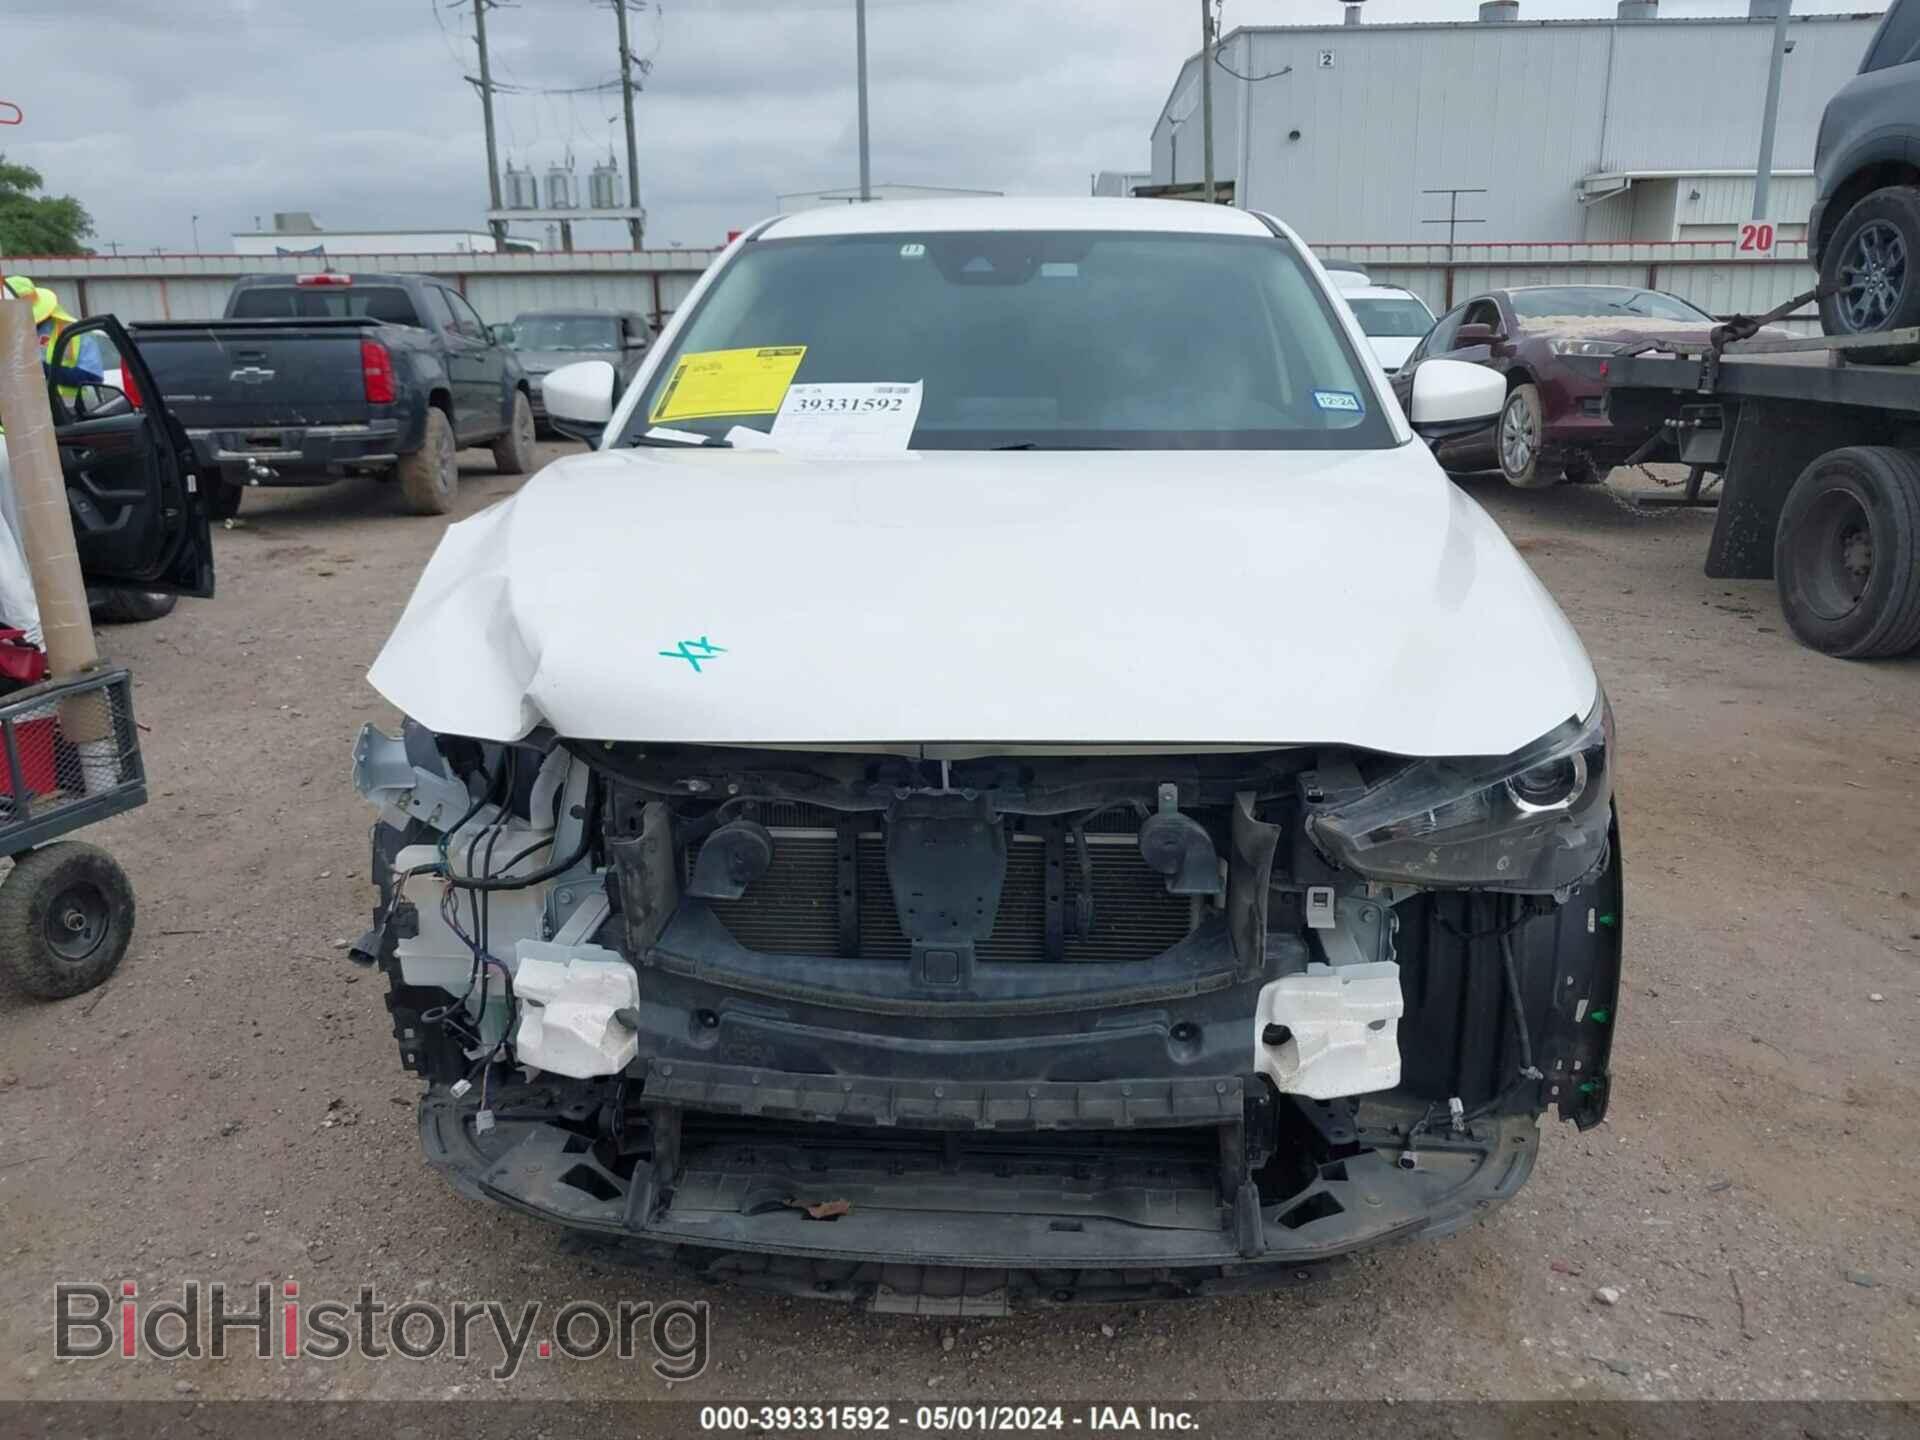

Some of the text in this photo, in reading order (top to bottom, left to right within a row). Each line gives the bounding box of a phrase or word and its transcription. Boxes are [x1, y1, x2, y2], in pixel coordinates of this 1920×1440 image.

[1322, 54, 1332, 66] 2
[1740, 224, 1774, 251] 20
[793, 398, 903, 412] 39331592
